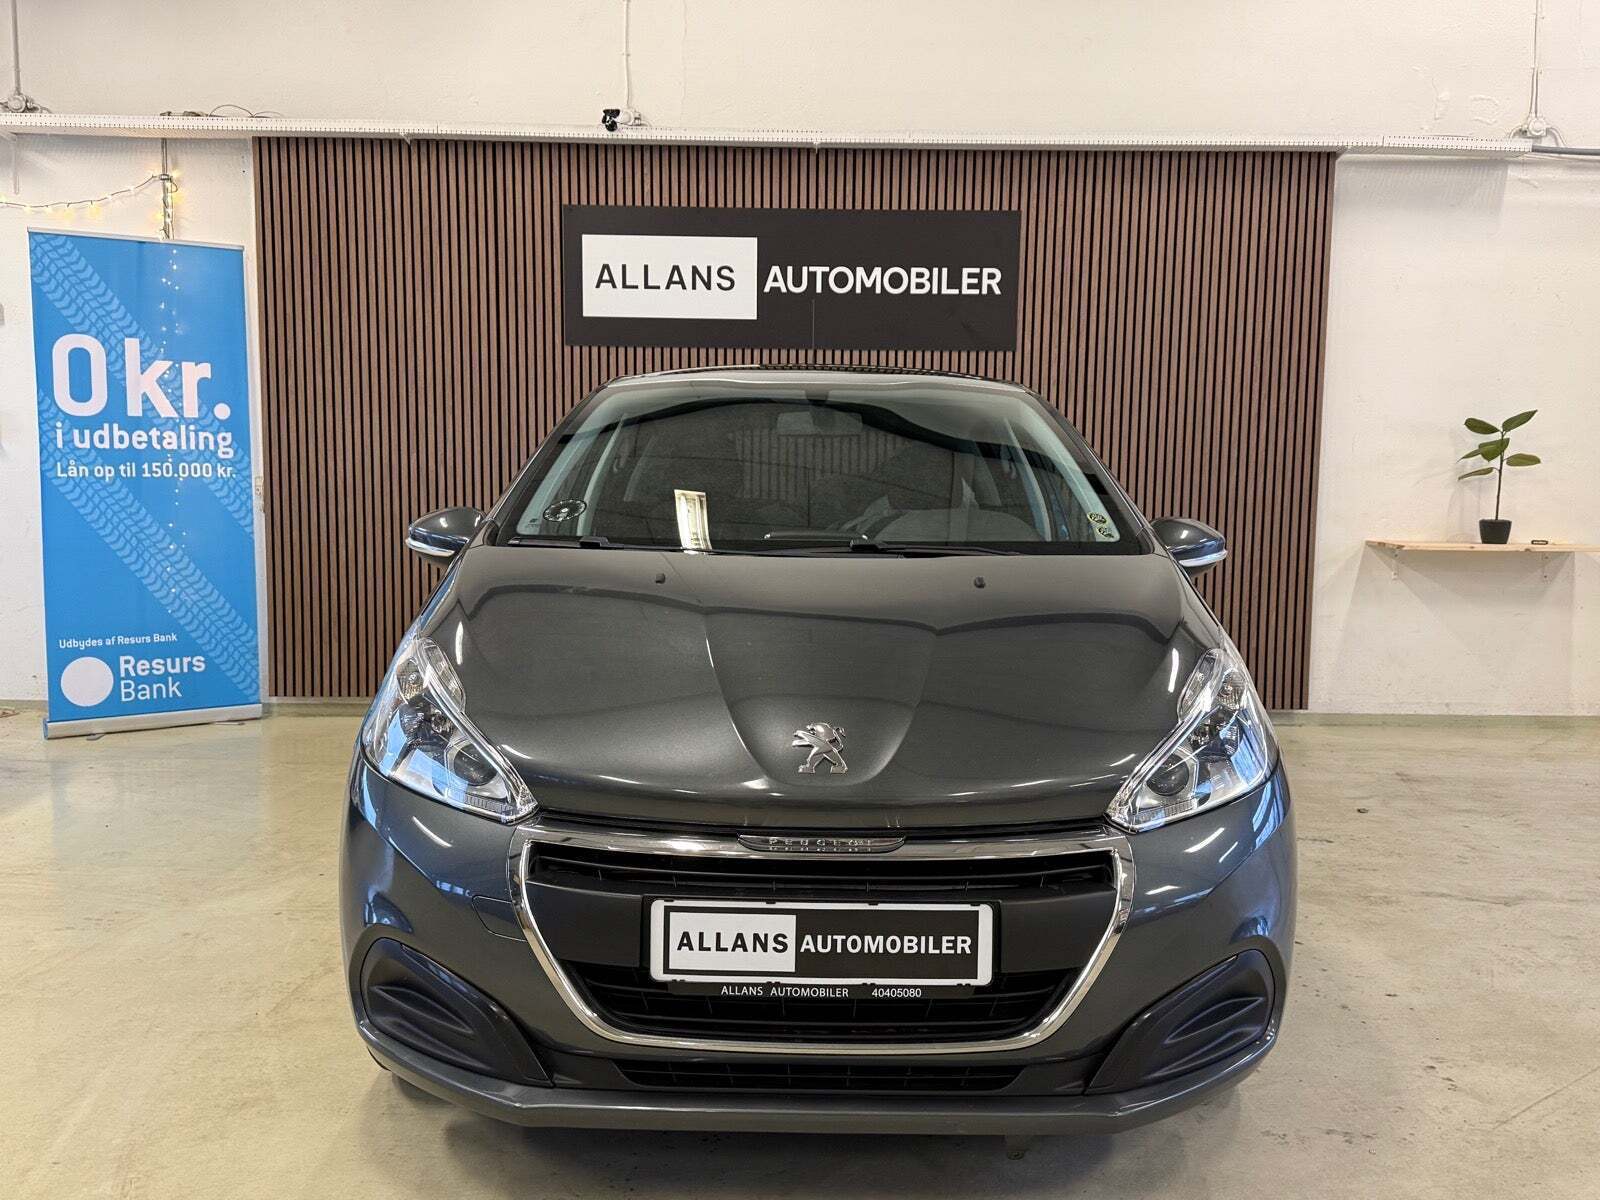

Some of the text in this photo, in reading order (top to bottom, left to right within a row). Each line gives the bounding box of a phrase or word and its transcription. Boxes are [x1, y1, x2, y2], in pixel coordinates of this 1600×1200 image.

[595, 263, 1002, 295] ALLANS AUTOMOBILER
[124, 337, 231, 420] kr.
[55, 421, 234, 459] i udbetaling
[57, 460, 236, 481] Lån op til 150.000 kr.
[59, 633, 178, 650] Udbydes af Resurs Bank
[119, 655, 206, 678] Resurs
[120, 677, 182, 702] Bank
[677, 931, 972, 955] ALLANS AUTOMOBILER
[720, 985, 922, 998] ALLANS AUTOMOBILER 40405080
